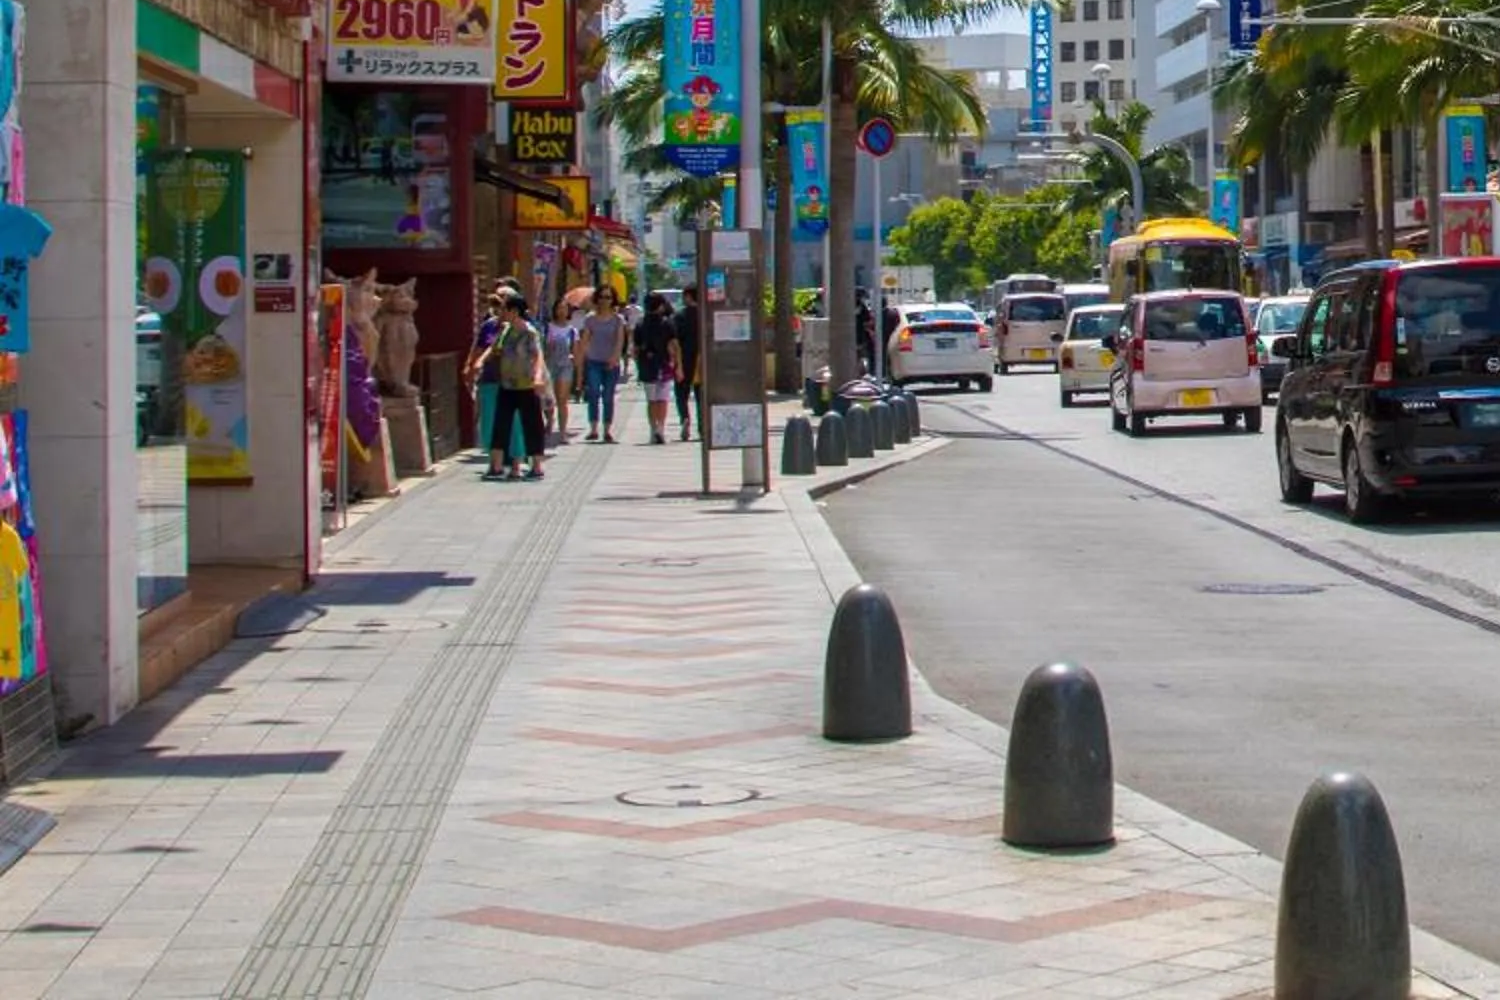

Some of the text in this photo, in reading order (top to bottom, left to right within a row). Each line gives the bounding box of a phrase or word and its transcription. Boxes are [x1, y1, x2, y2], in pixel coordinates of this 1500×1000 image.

[365, 60, 480, 76] リラックスプラス
[512, 111, 574, 135] Habu
[516, 135, 568, 160] Box
